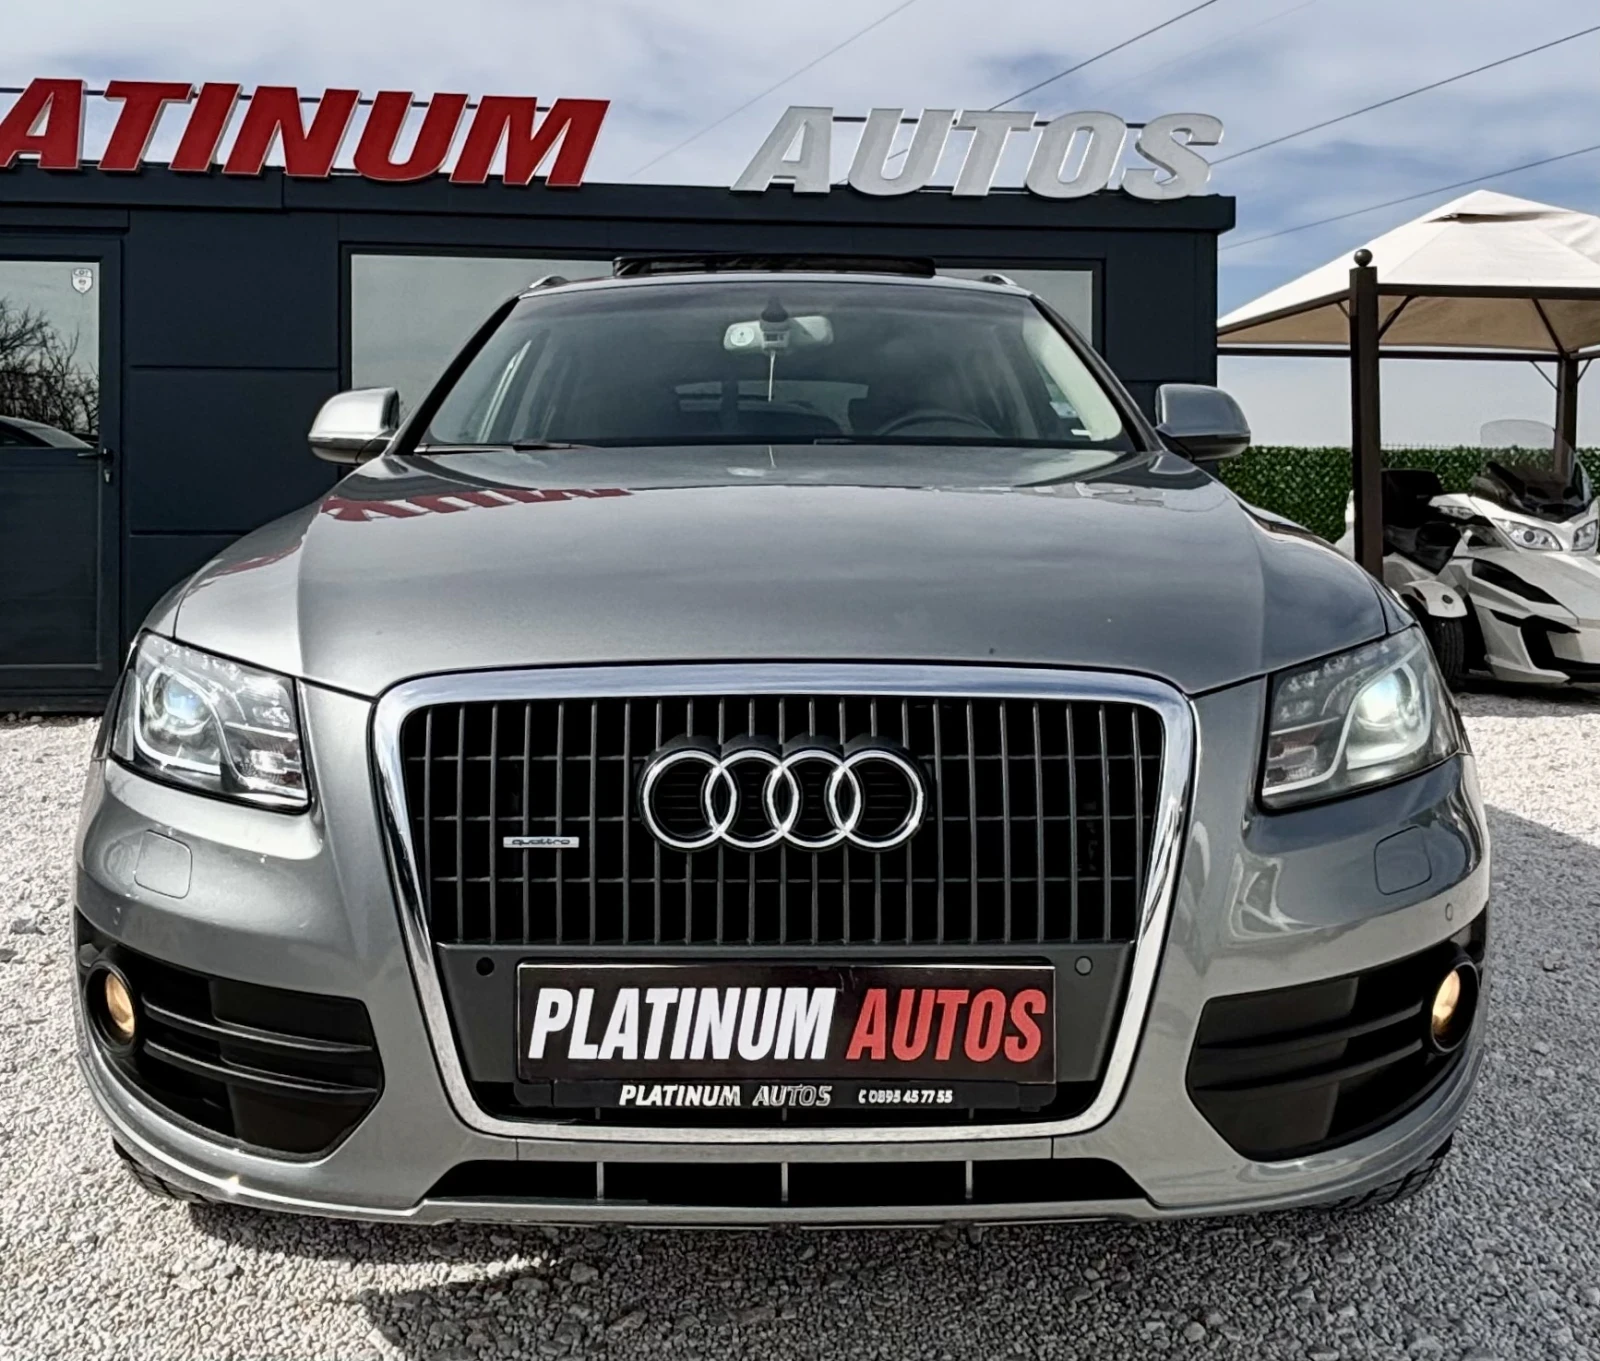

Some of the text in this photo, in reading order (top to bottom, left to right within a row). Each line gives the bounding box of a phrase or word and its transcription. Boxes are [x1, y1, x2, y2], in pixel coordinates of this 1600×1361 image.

[0, 77, 1224, 200] ATINUM AUTOS
[511, 838, 571, 846] quattro
[528, 987, 1047, 1062] PLATINUM AUTOS
[619, 1084, 833, 1107] PLATINUM AUTOS
[902, 1089, 920, 1104] 45
[920, 1089, 936, 1104] 77
[936, 1089, 953, 1104] 55
